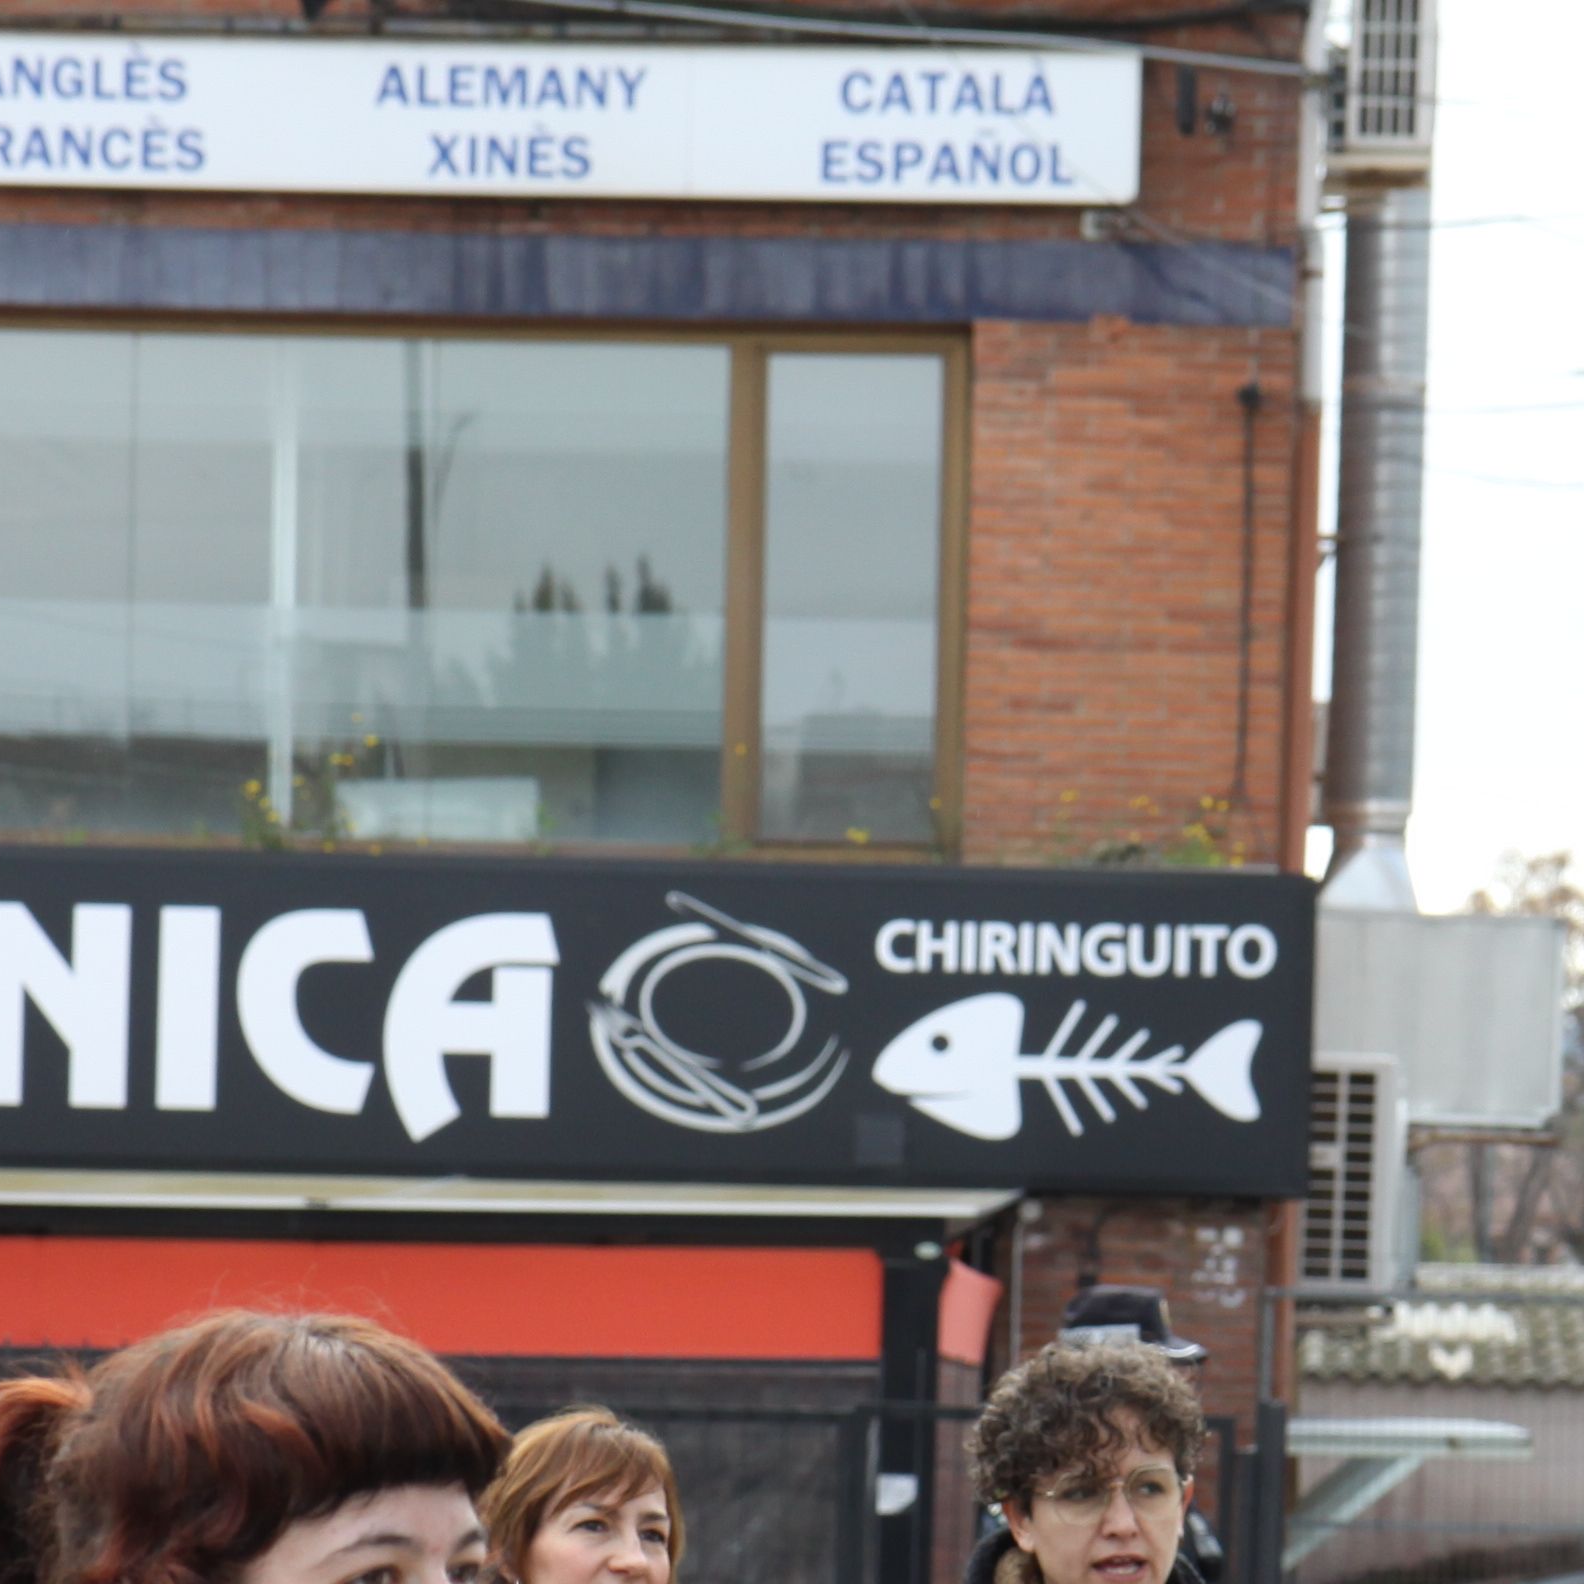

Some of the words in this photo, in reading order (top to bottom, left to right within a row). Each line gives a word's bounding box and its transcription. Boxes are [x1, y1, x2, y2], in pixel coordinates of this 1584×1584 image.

[375, 63, 647, 109] ALEMANY
[839, 54, 1056, 115] CATALÀ
[428, 123, 591, 178] XINÈS
[820, 128, 1074, 185] ESPAÑOL
[874, 918, 1278, 978] CHIRINGUITO
